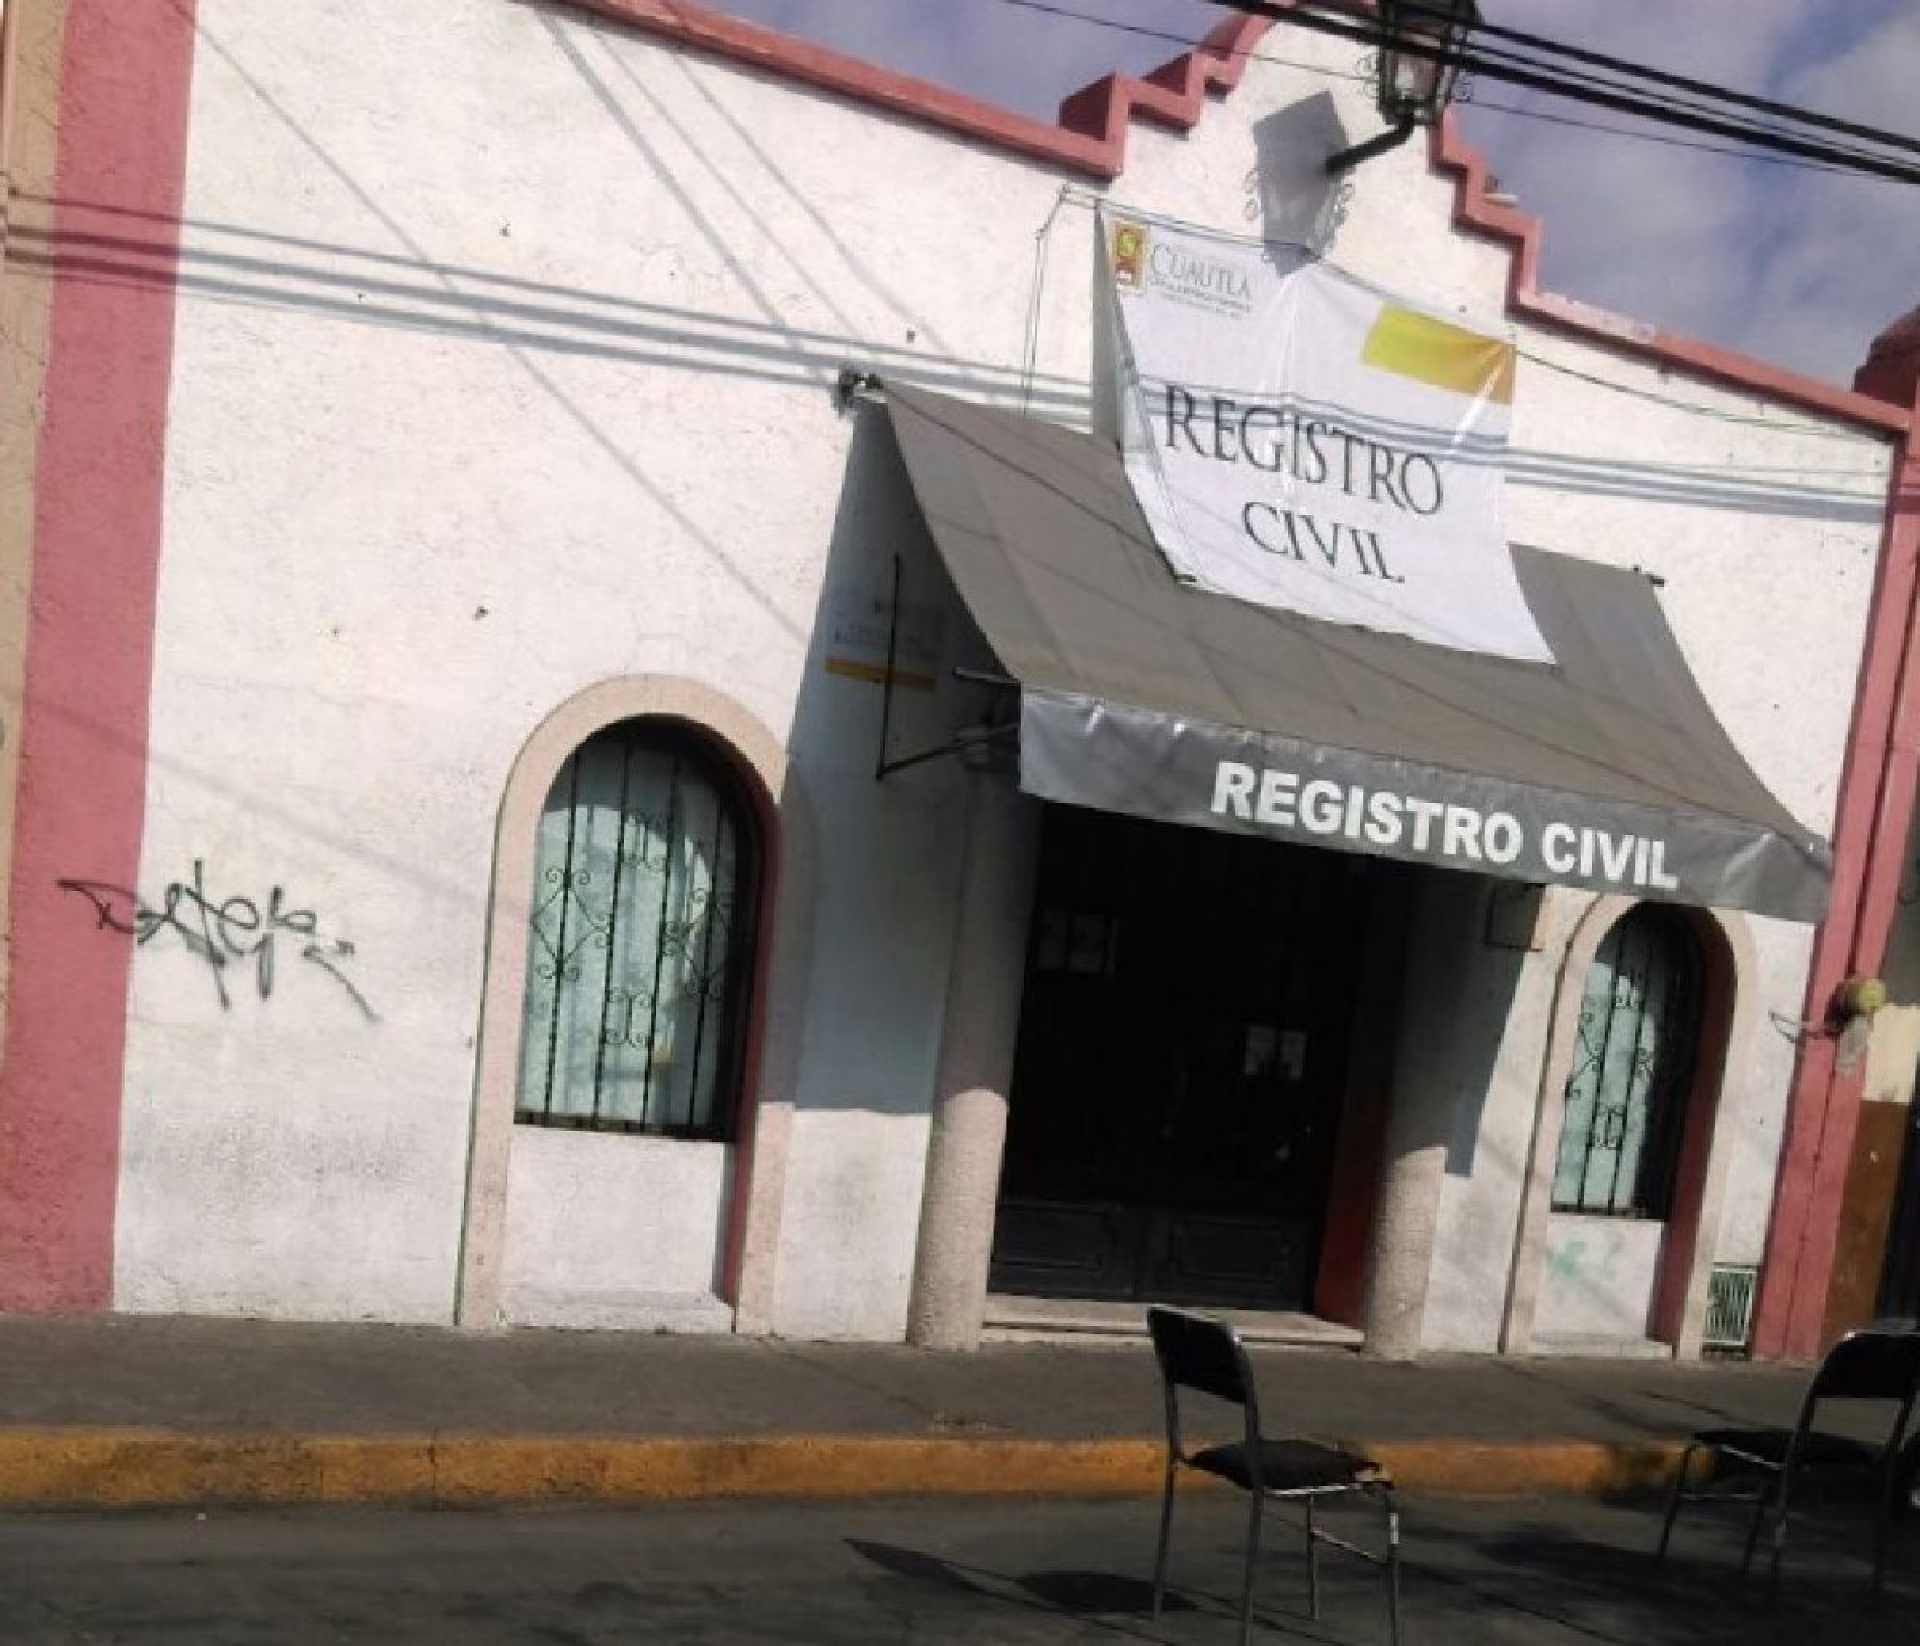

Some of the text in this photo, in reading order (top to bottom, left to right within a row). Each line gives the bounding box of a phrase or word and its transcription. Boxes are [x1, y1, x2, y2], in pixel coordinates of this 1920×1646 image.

[1151, 243, 1252, 299] CUAUTLA
[1165, 385, 1443, 516] REGISTRO
[1244, 501, 1405, 583] CIVIL
[1211, 761, 1678, 890] REGISTRO CIVIL
